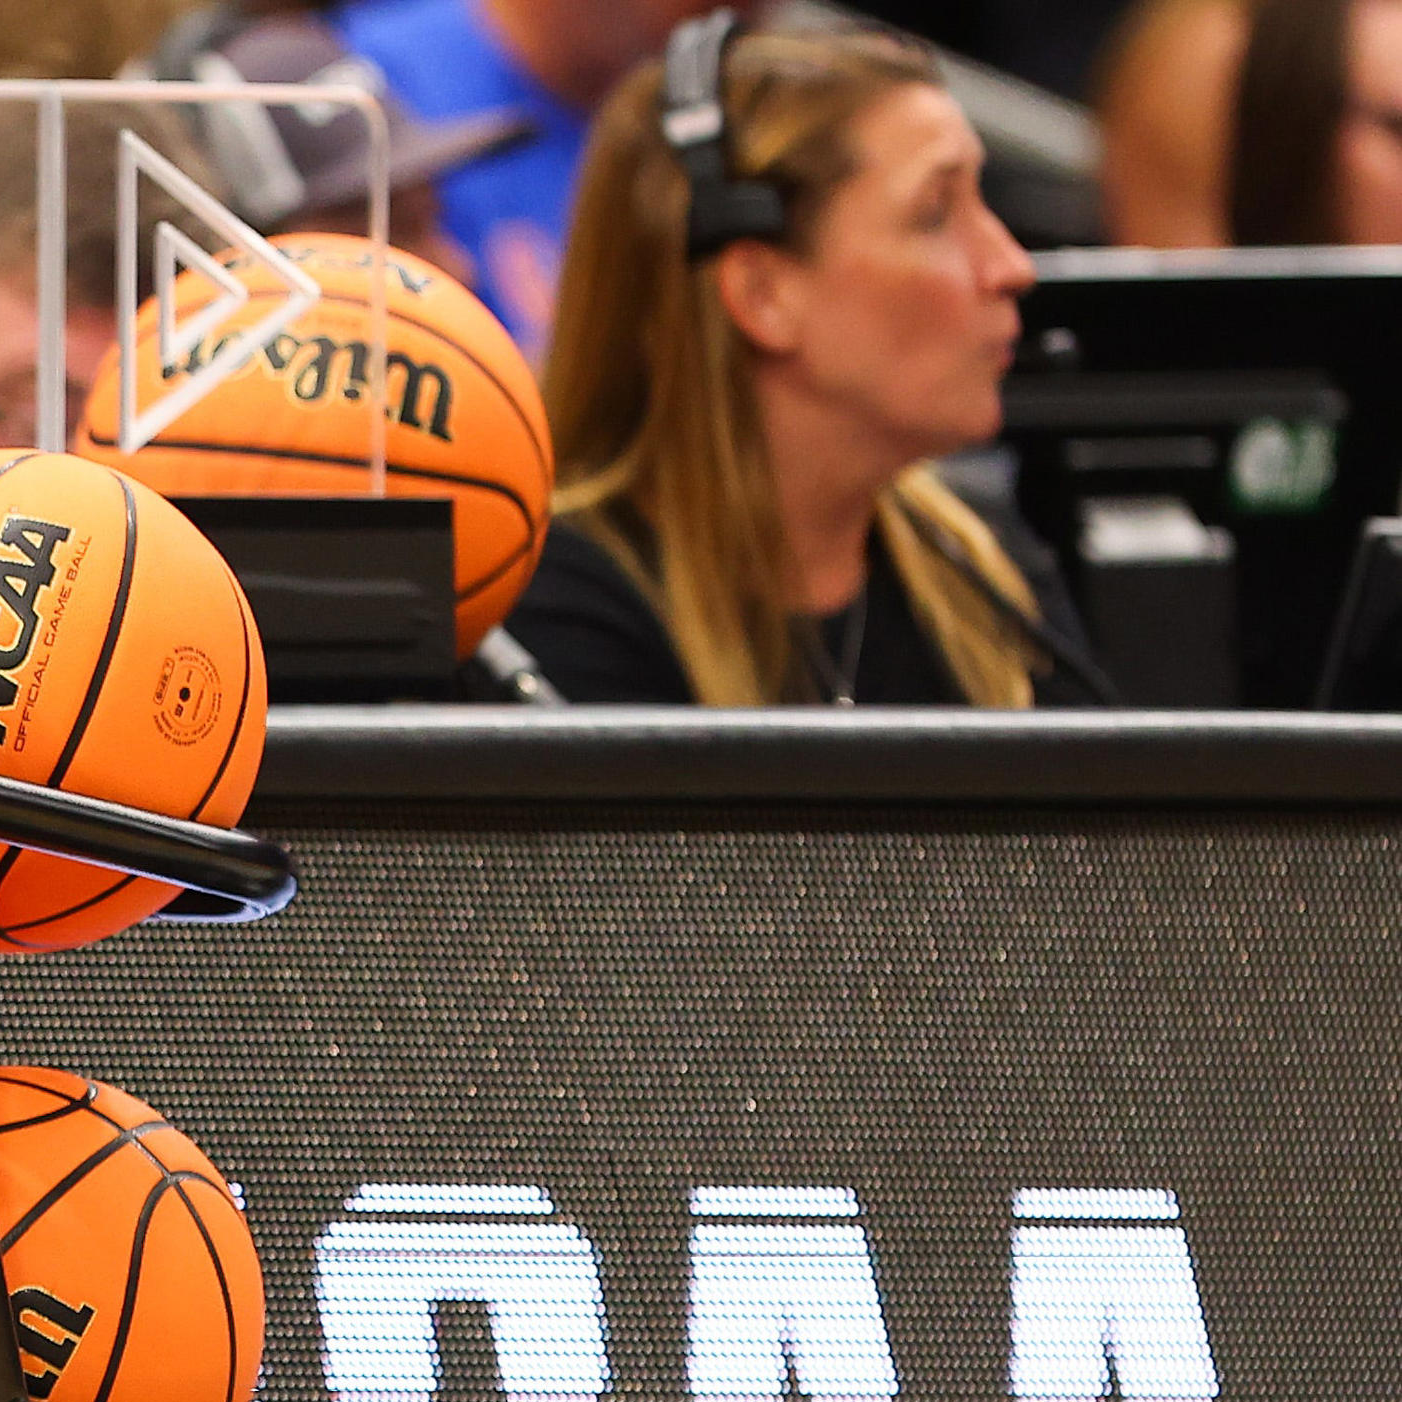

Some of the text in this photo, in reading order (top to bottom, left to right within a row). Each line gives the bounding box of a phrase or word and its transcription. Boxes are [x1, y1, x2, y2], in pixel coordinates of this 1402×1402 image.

[163, 334, 453, 443] Wils
[13, 535, 93, 753] OFFICIAL GAME BALL
